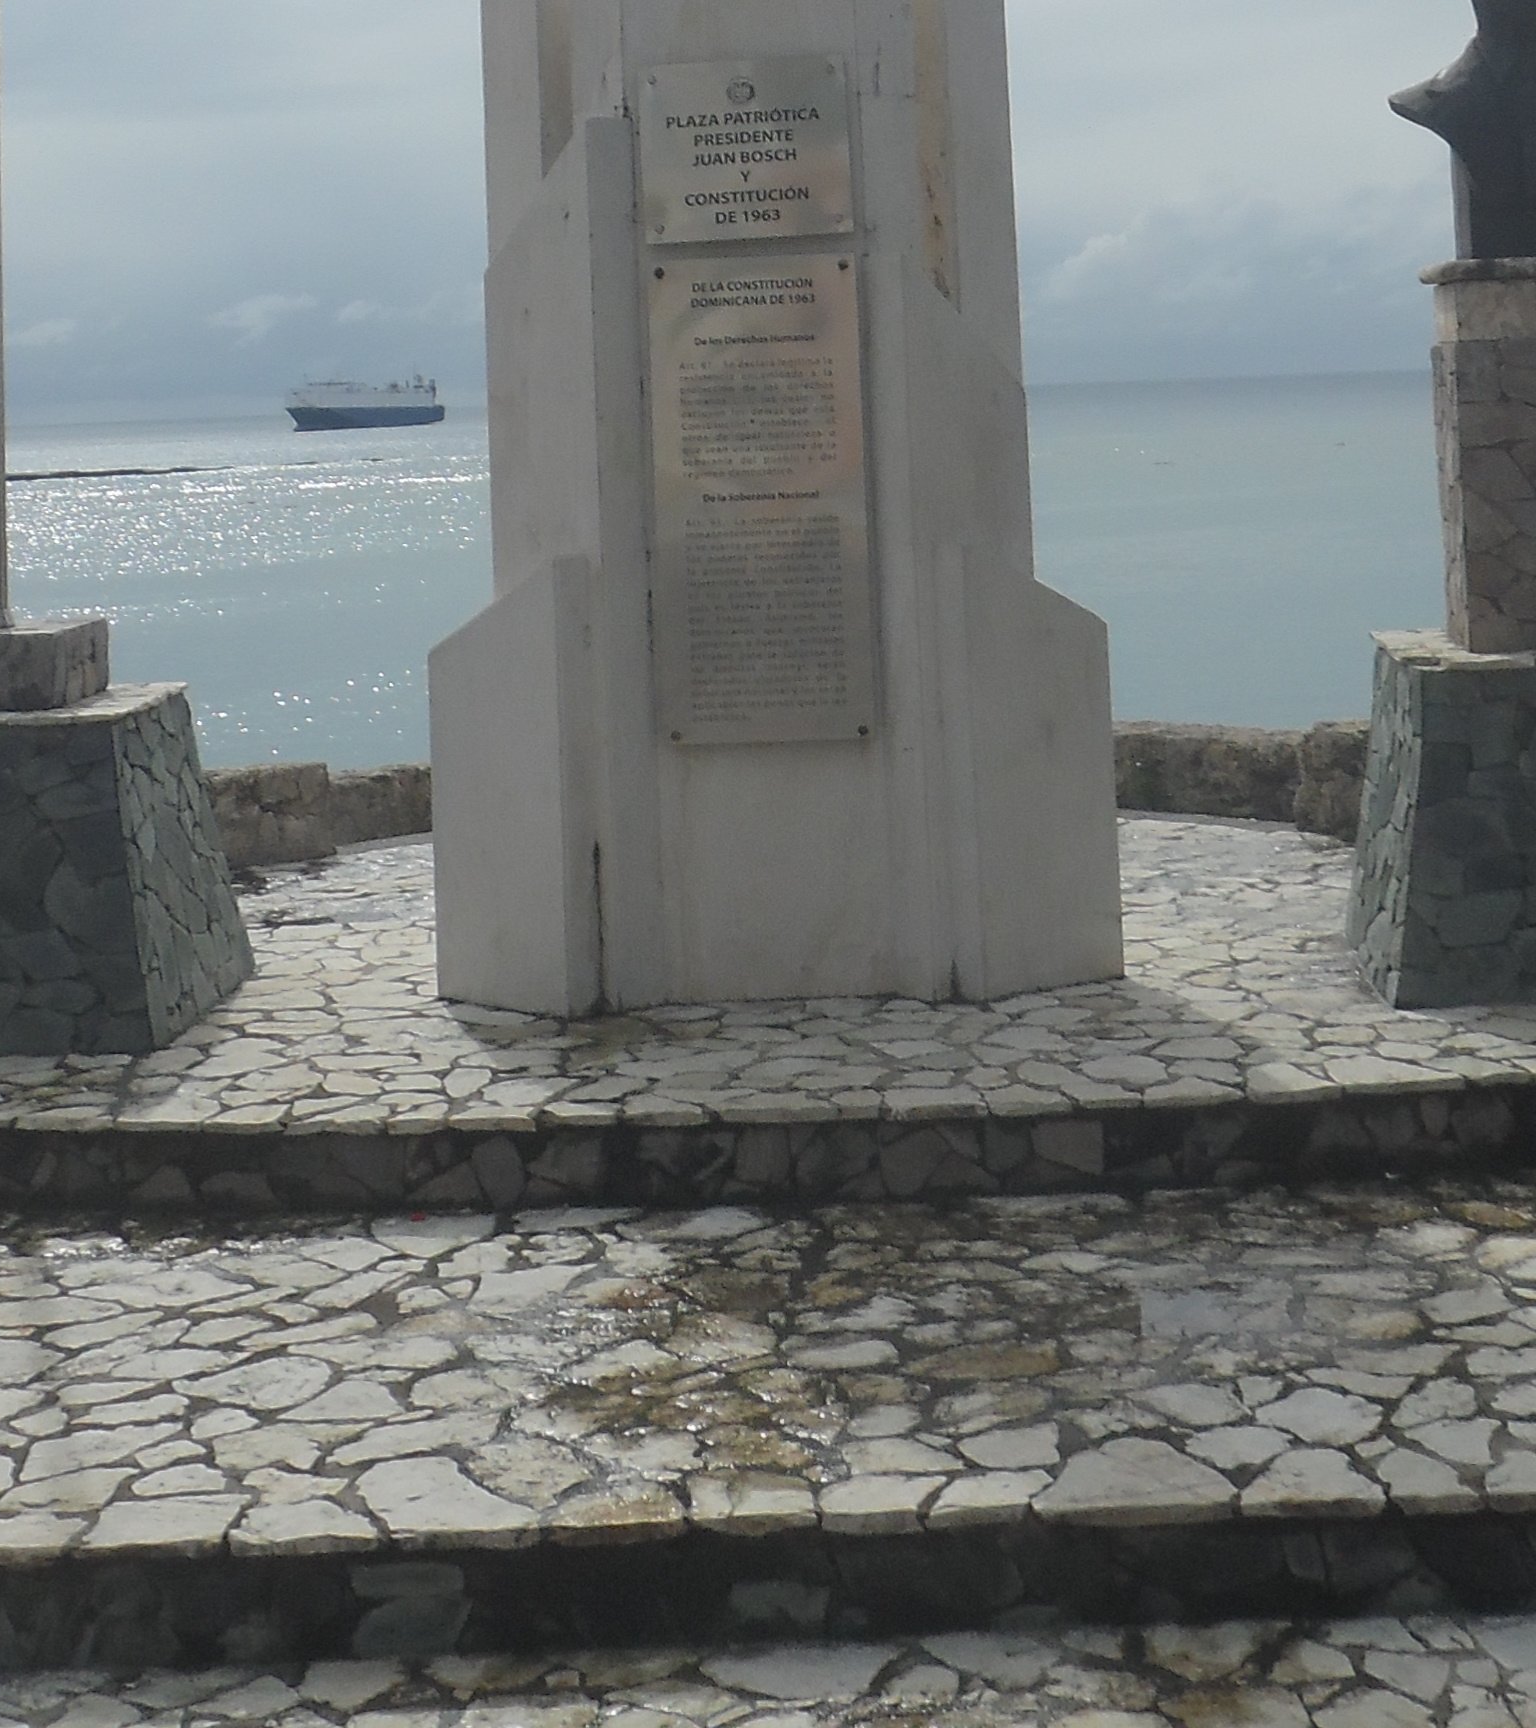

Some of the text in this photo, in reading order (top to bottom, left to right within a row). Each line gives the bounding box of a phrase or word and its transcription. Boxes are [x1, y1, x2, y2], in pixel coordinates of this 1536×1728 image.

[666, 107, 820, 129] PLAZA PATRIÓTICA
[693, 129, 794, 146] PRESIDENTE
[692, 147, 797, 167] JUAN BOSCH
[740, 171, 751, 183] Y
[684, 186, 810, 207] CONSTITUCIÓN
[715, 209, 781, 225] DE 1963
[692, 276, 813, 293] DE LA CONSTITUCIÓN
[690, 292, 816, 309] DOMINICANA DE 1963
